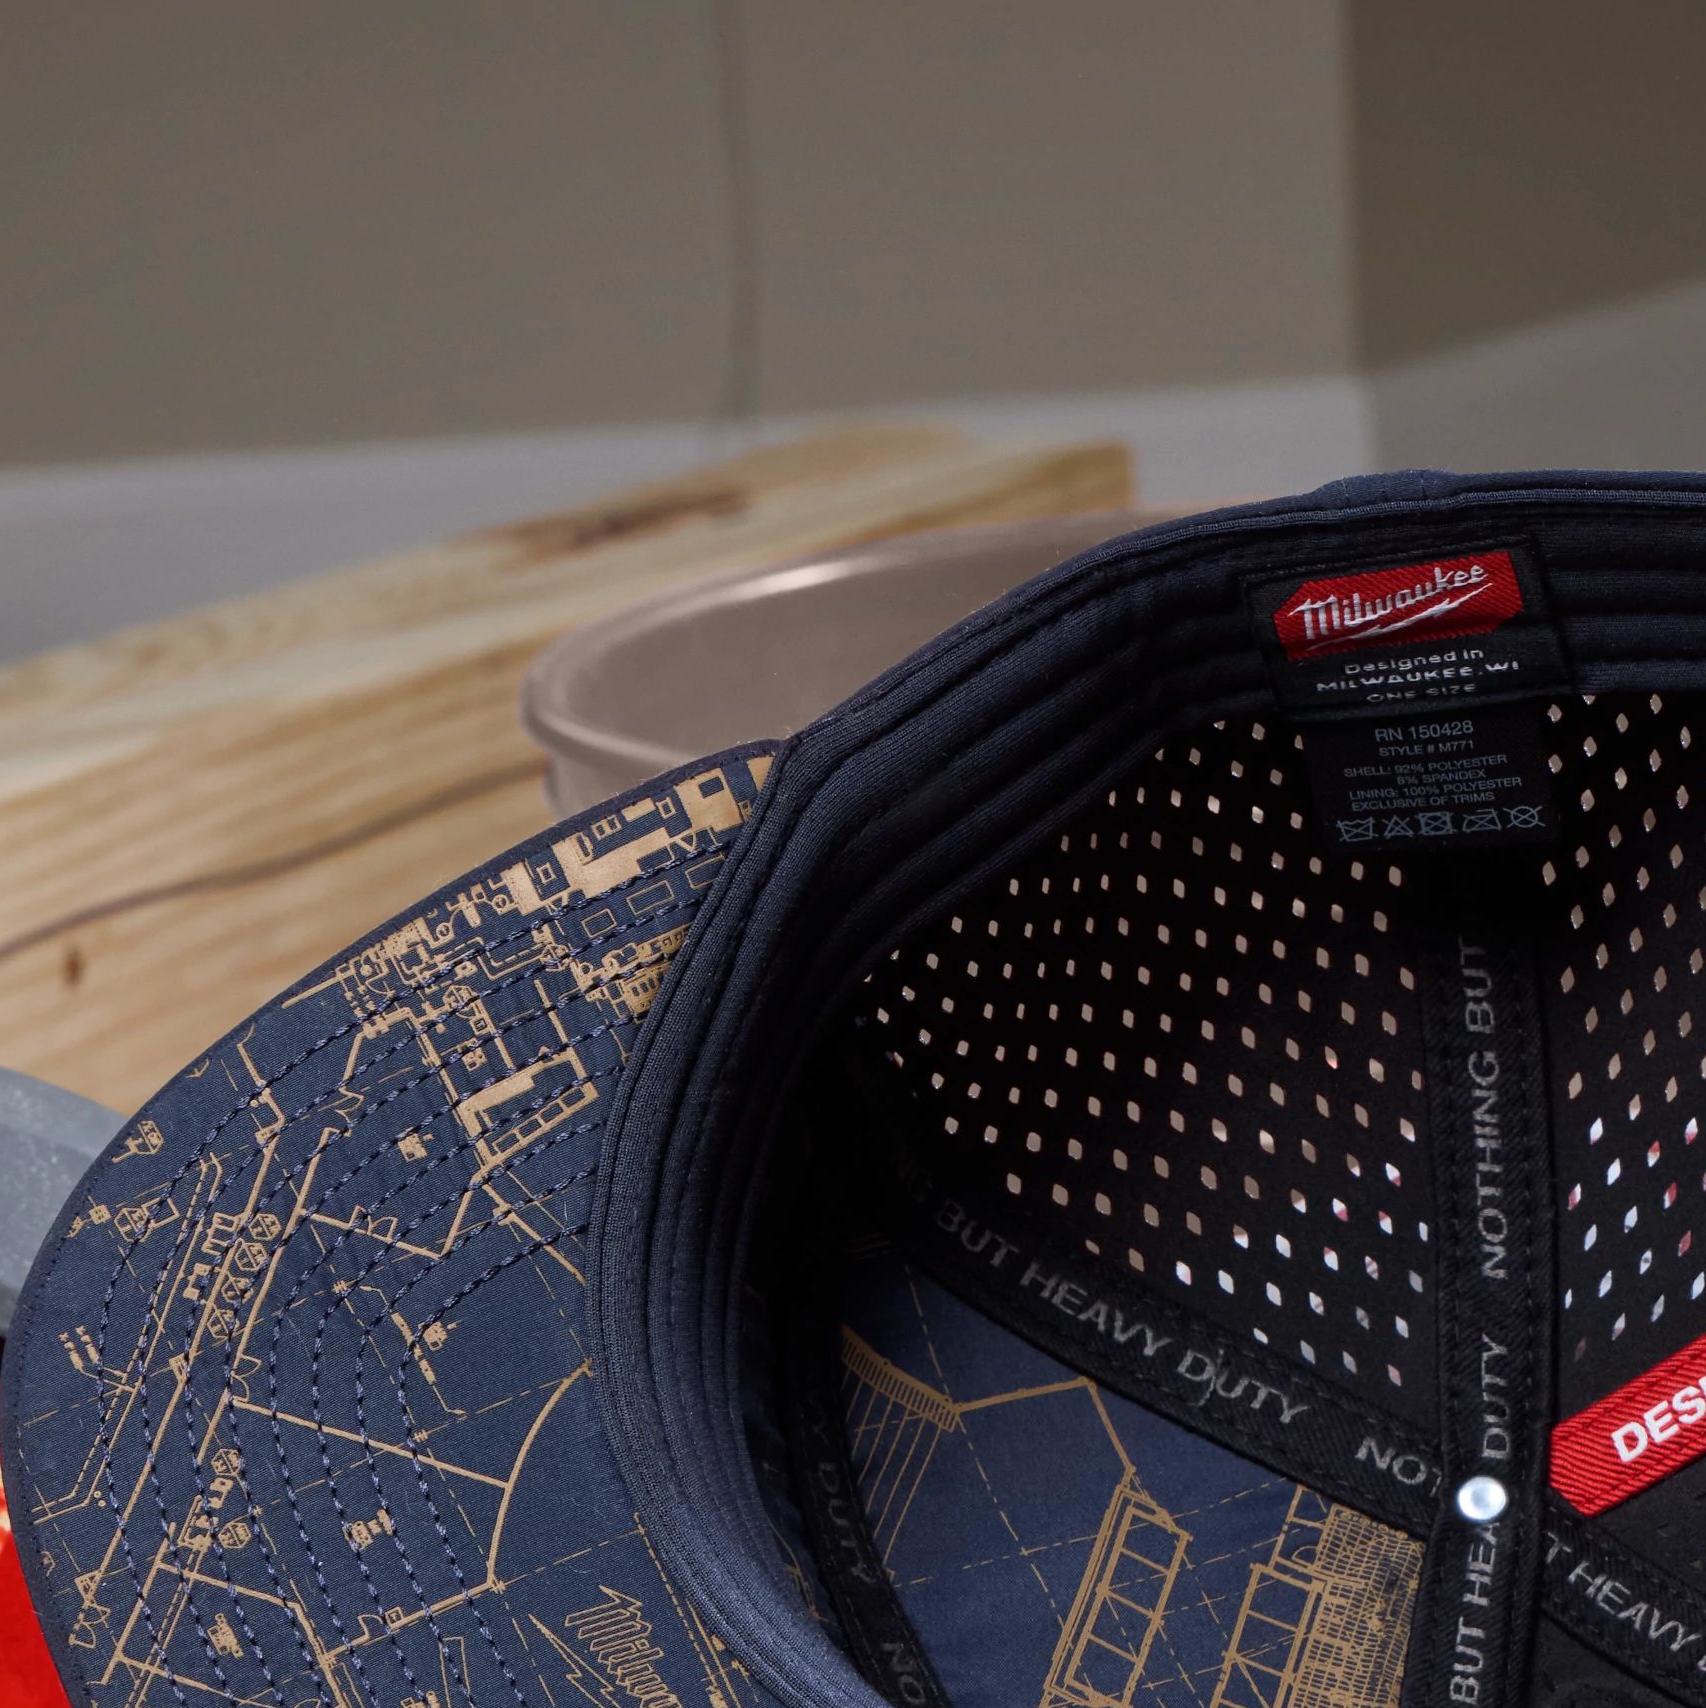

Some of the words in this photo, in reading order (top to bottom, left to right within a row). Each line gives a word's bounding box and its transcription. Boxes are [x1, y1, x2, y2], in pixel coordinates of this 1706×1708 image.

[1287, 564, 1489, 640] Milwaukee
[1344, 650, 1457, 675] Designed
[1485, 660, 1520, 672] WI
[1365, 689, 1417, 703] ONE
[1425, 683, 1477, 697] SIZE
[1374, 726, 1403, 743] RN
[1409, 719, 1475, 741] 150428
[1379, 744, 1424, 757] STYLE
[1438, 739, 1474, 754] M771
[1395, 763, 1425, 775] 92%
[1428, 753, 1509, 773] POLYESTER
[1397, 774, 1419, 786] 8%
[1422, 768, 1487, 784] SPANDEX
[1403, 784, 1440, 797] 100%
[1443, 776, 1523, 794] POLYESTER
[1351, 798, 1427, 812] EXCLUSIVE
[1432, 795, 1448, 806] OF
[1451, 791, 1496, 805] TRIMS
[1458, 933, 1494, 1035] BUT
[1466, 1050, 1509, 1281] NOTHING
[936, 1198, 1021, 1269] BUT
[1018, 1261, 1174, 1358] HEAVY
[1176, 1350, 1309, 1425] DUTY
[1480, 1331, 1511, 1460] DUTY
[818, 1461, 876, 1584] DUTY
[1462, 1520, 1501, 1607] HEA
[1567, 1560, 1701, 1652] HEAVY
[1449, 1616, 1486, 1705] BUT
